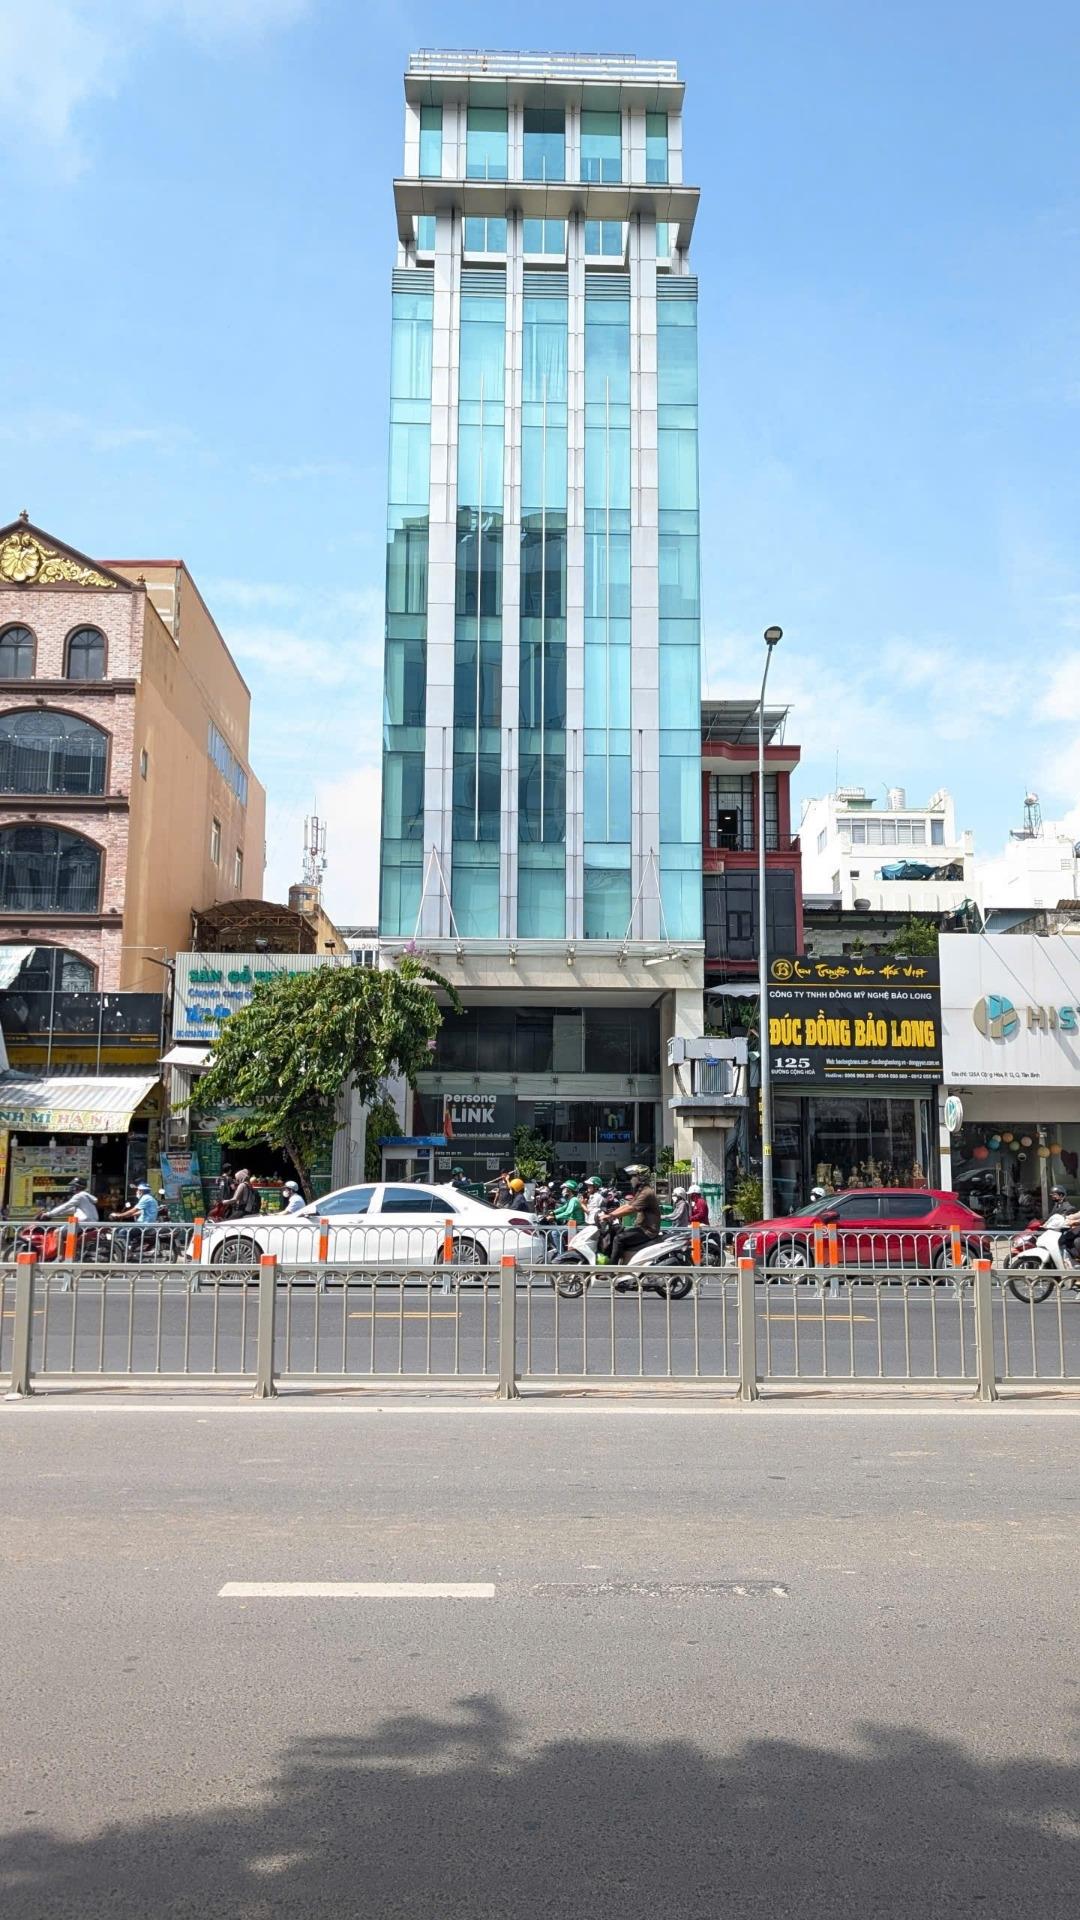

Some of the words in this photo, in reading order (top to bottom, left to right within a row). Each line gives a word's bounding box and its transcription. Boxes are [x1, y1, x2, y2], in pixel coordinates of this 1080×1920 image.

[769, 989, 793, 999] CÔNG
[794, 991, 805, 999] TY
[806, 991, 828, 999] TNHH
[867, 990, 890, 1000] NGHỆ
[910, 992, 933, 1001] LONG
[1027, 1005, 1080, 1030] HIS
[769, 1012, 803, 1046] ĐÚC
[805, 1009, 851, 1047] ĐỒNG
[854, 1012, 888, 1047] BẢO
[891, 1019, 936, 1048] LONG
[774, 1057, 811, 1069] 125
[444, 1094, 497, 1103] persona
[451, 1108, 495, 1123] LINK
